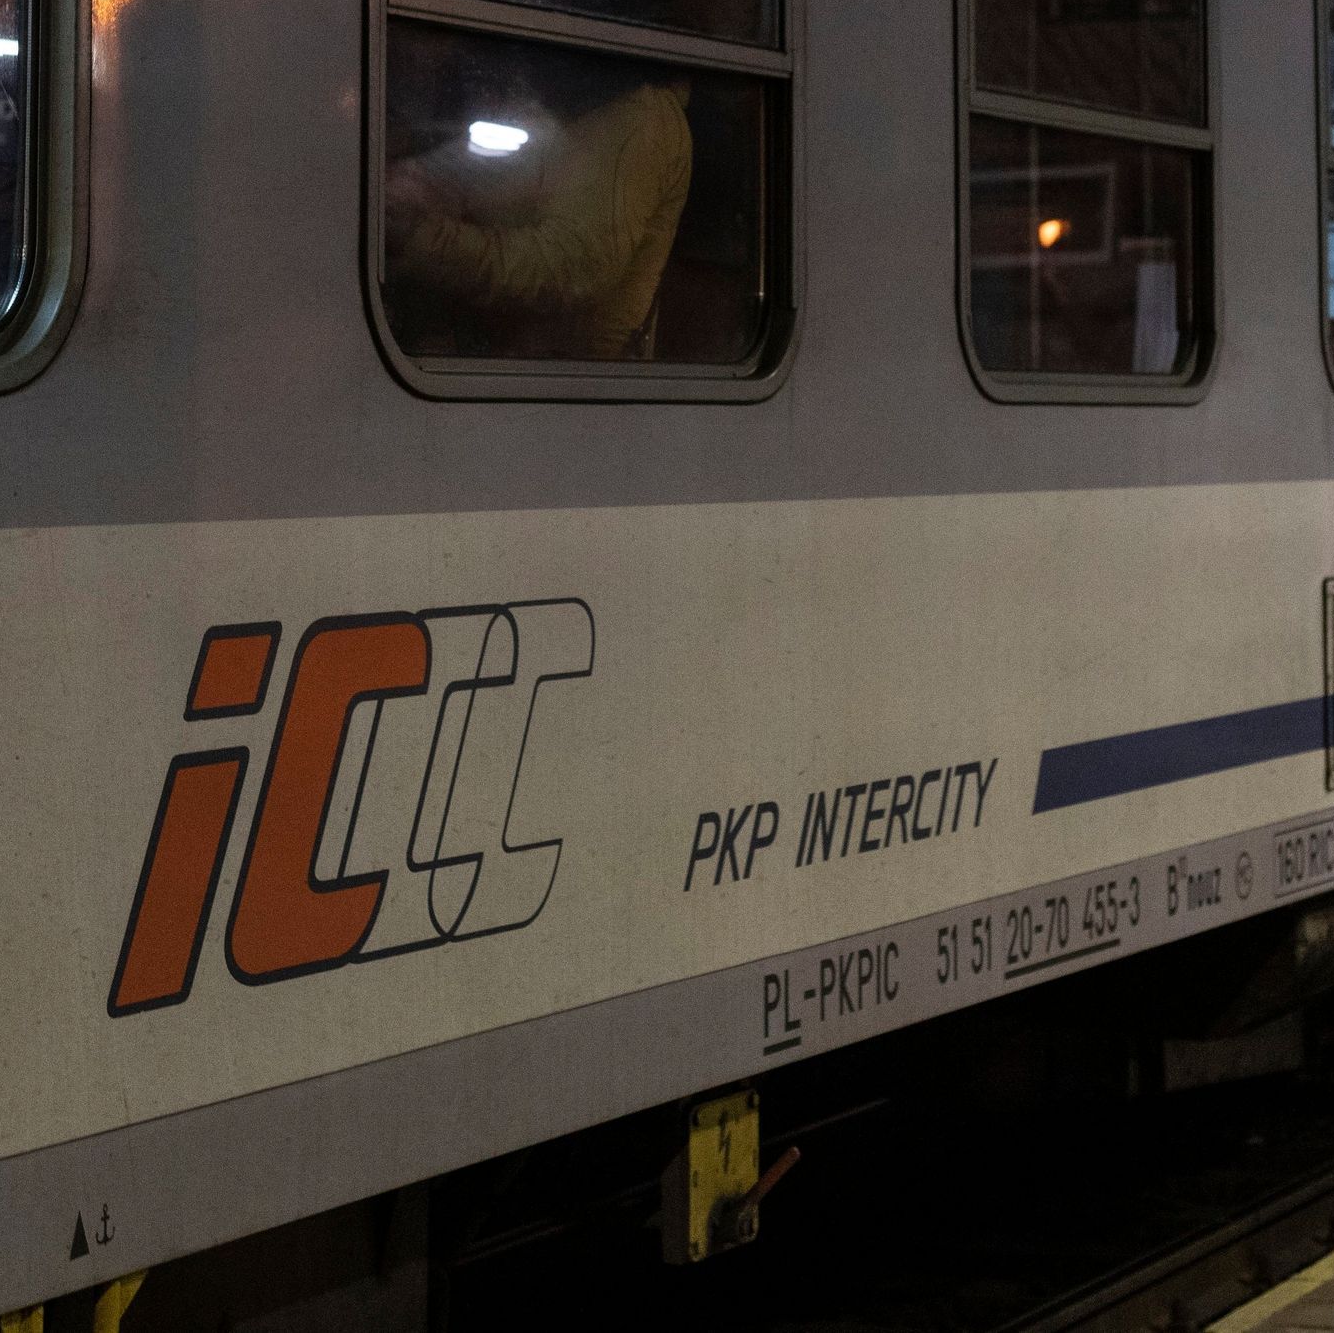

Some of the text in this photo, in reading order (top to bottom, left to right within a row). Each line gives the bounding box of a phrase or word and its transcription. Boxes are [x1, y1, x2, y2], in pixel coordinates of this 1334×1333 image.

[683, 758, 999, 892] PKP INTERCITY
[763, 941, 900, 1038] PL-PKPIC
